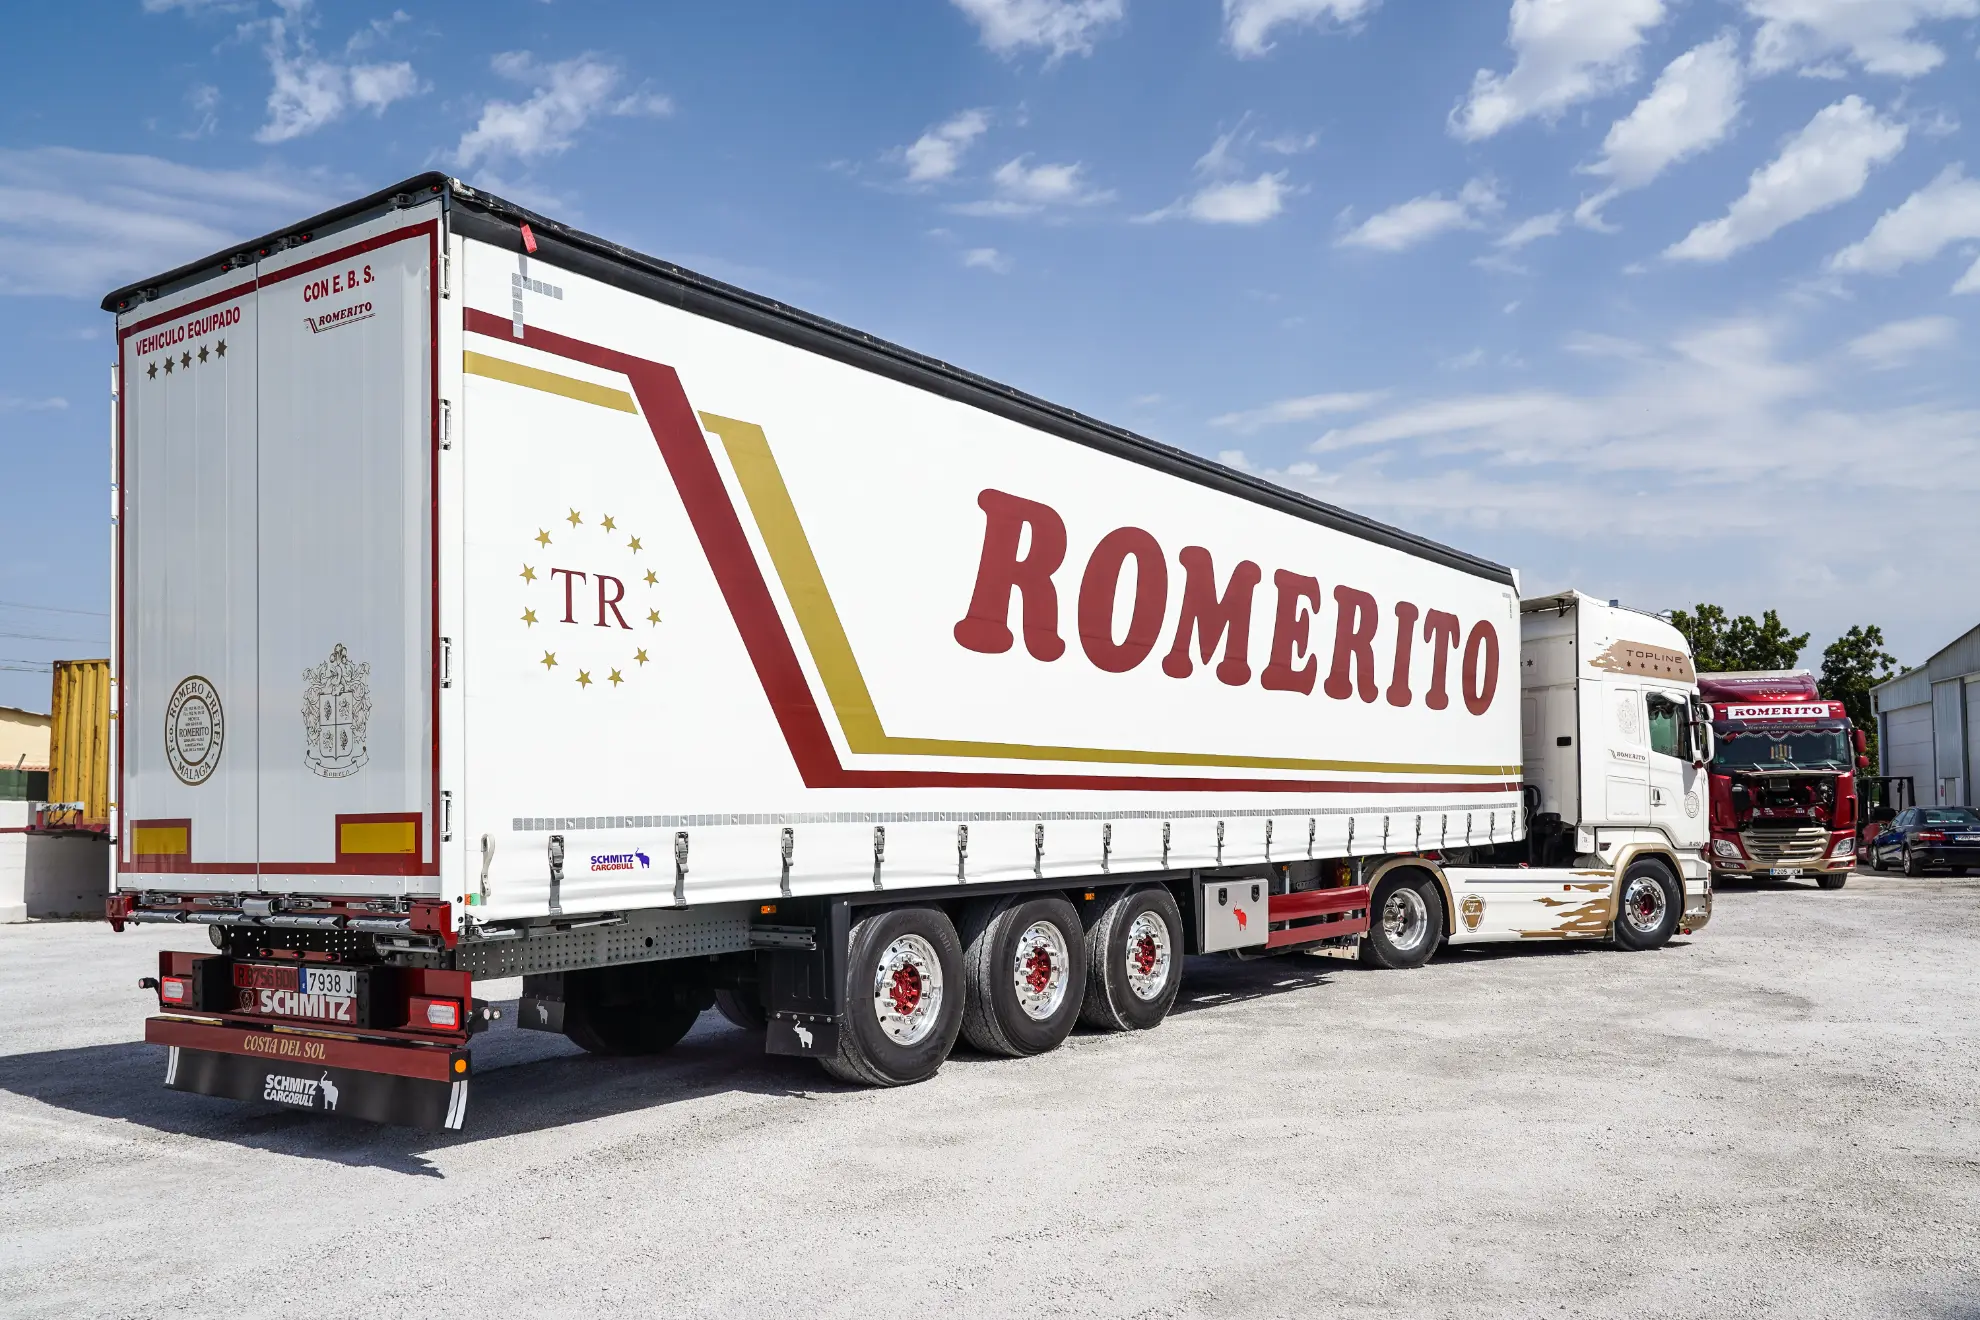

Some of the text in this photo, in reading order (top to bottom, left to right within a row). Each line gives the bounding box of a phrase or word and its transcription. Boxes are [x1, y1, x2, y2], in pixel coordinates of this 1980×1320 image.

[303, 264, 375, 303] CON E. B. S.
[318, 301, 373, 326] ROMERITO
[136, 306, 241, 357] VEHICULO EQUIPADO
[551, 567, 634, 630] TR
[953, 488, 1499, 716] ROMERITO
[1626, 649, 1683, 664] TOPLINE
[169, 682, 205, 718] ROMERO
[205, 689, 221, 749] PRETEL
[1735, 706, 1823, 716] ROMERITO
[178, 726, 210, 738] ROMERITO
[1616, 752, 1646, 761] ROMERITO
[176, 761, 212, 780] MALAGA
[591, 854, 634, 864] SCHMITZ
[591, 862, 634, 872] CARGOBULL
[309, 973, 341, 993] 7938
[260, 989, 351, 1021] SCHMITZ
[243, 1034, 326, 1060] COSTA DEL SOL
[265, 1074, 318, 1094] SCHMITZ
[263, 1089, 315, 1108] CARGOBULL
